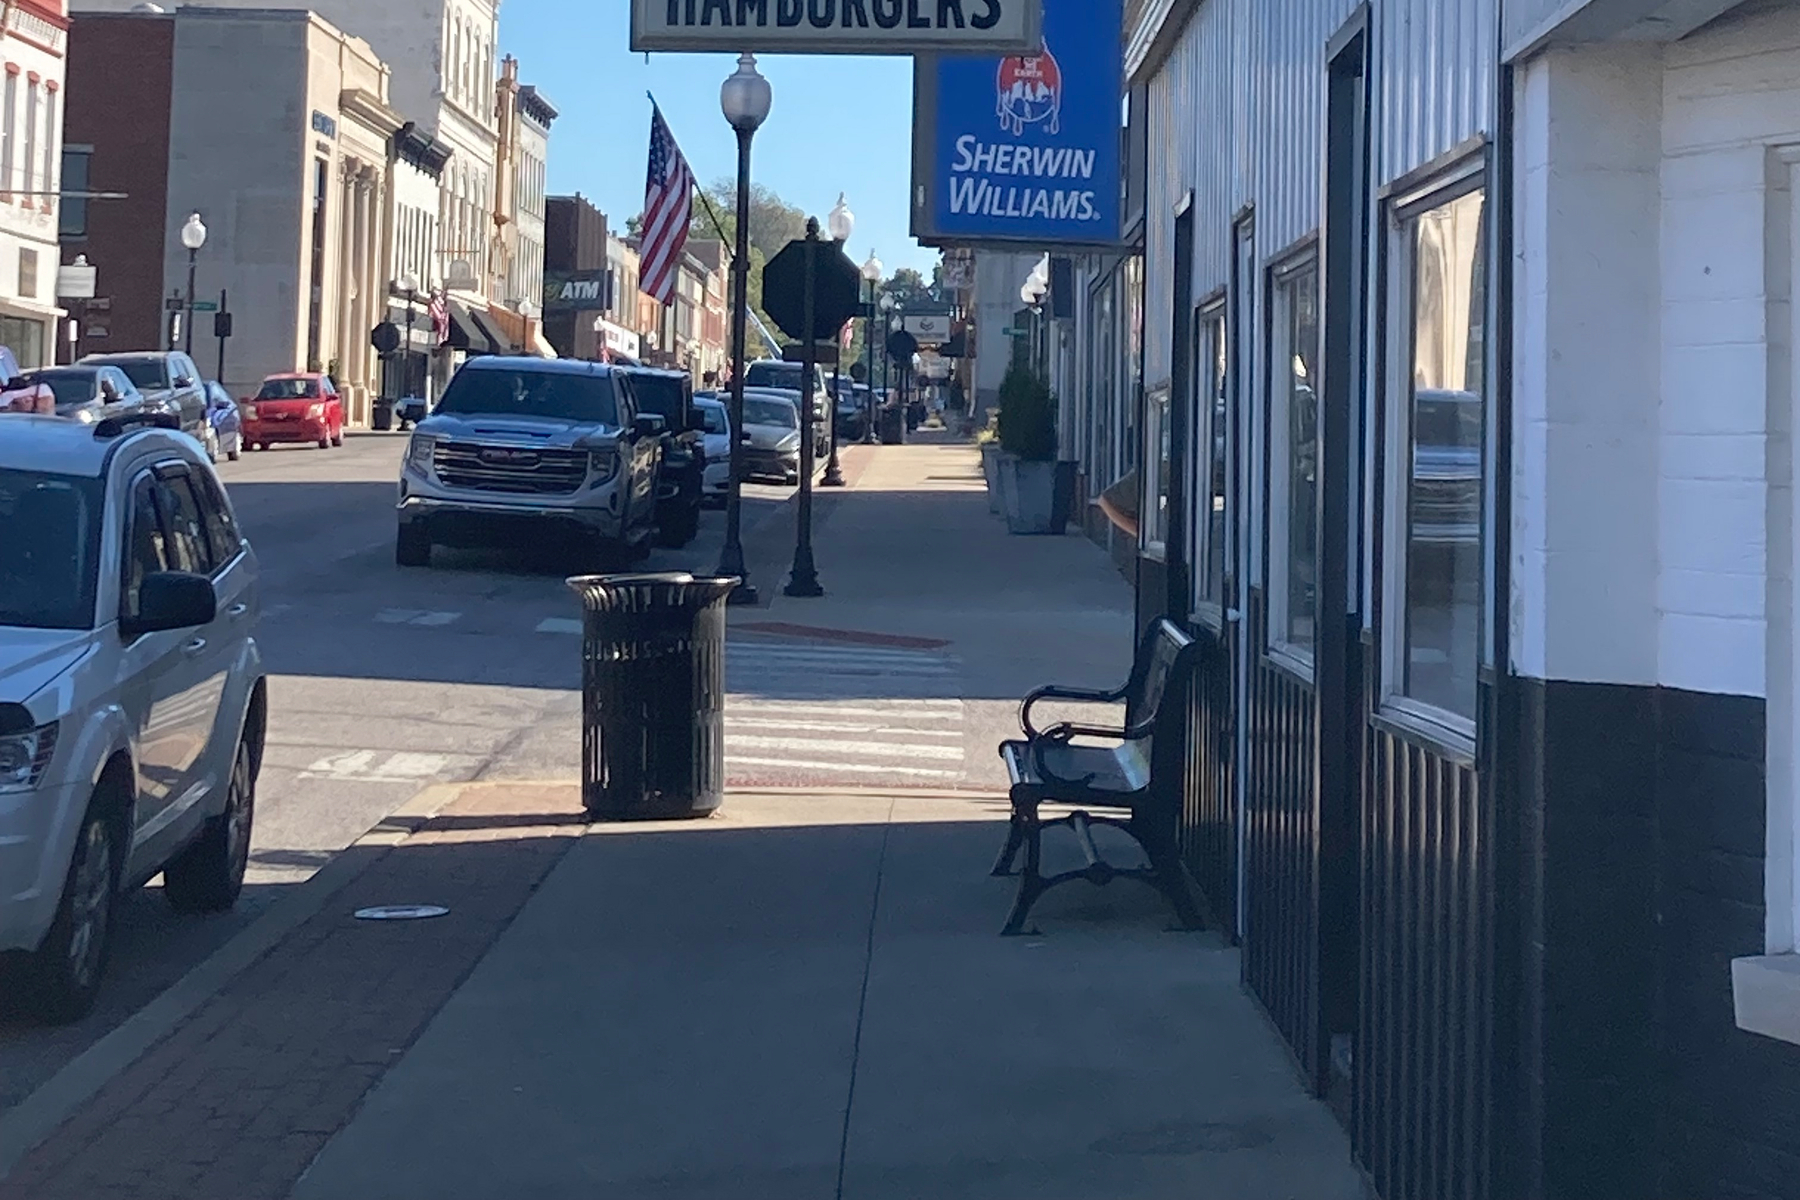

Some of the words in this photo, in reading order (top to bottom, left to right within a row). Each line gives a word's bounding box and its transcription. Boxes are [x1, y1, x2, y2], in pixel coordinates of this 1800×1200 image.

[952, 135, 1096, 179] SHERWIN
[950, 177, 1095, 221] WILLIAMS
[560, 281, 600, 299] ATM
